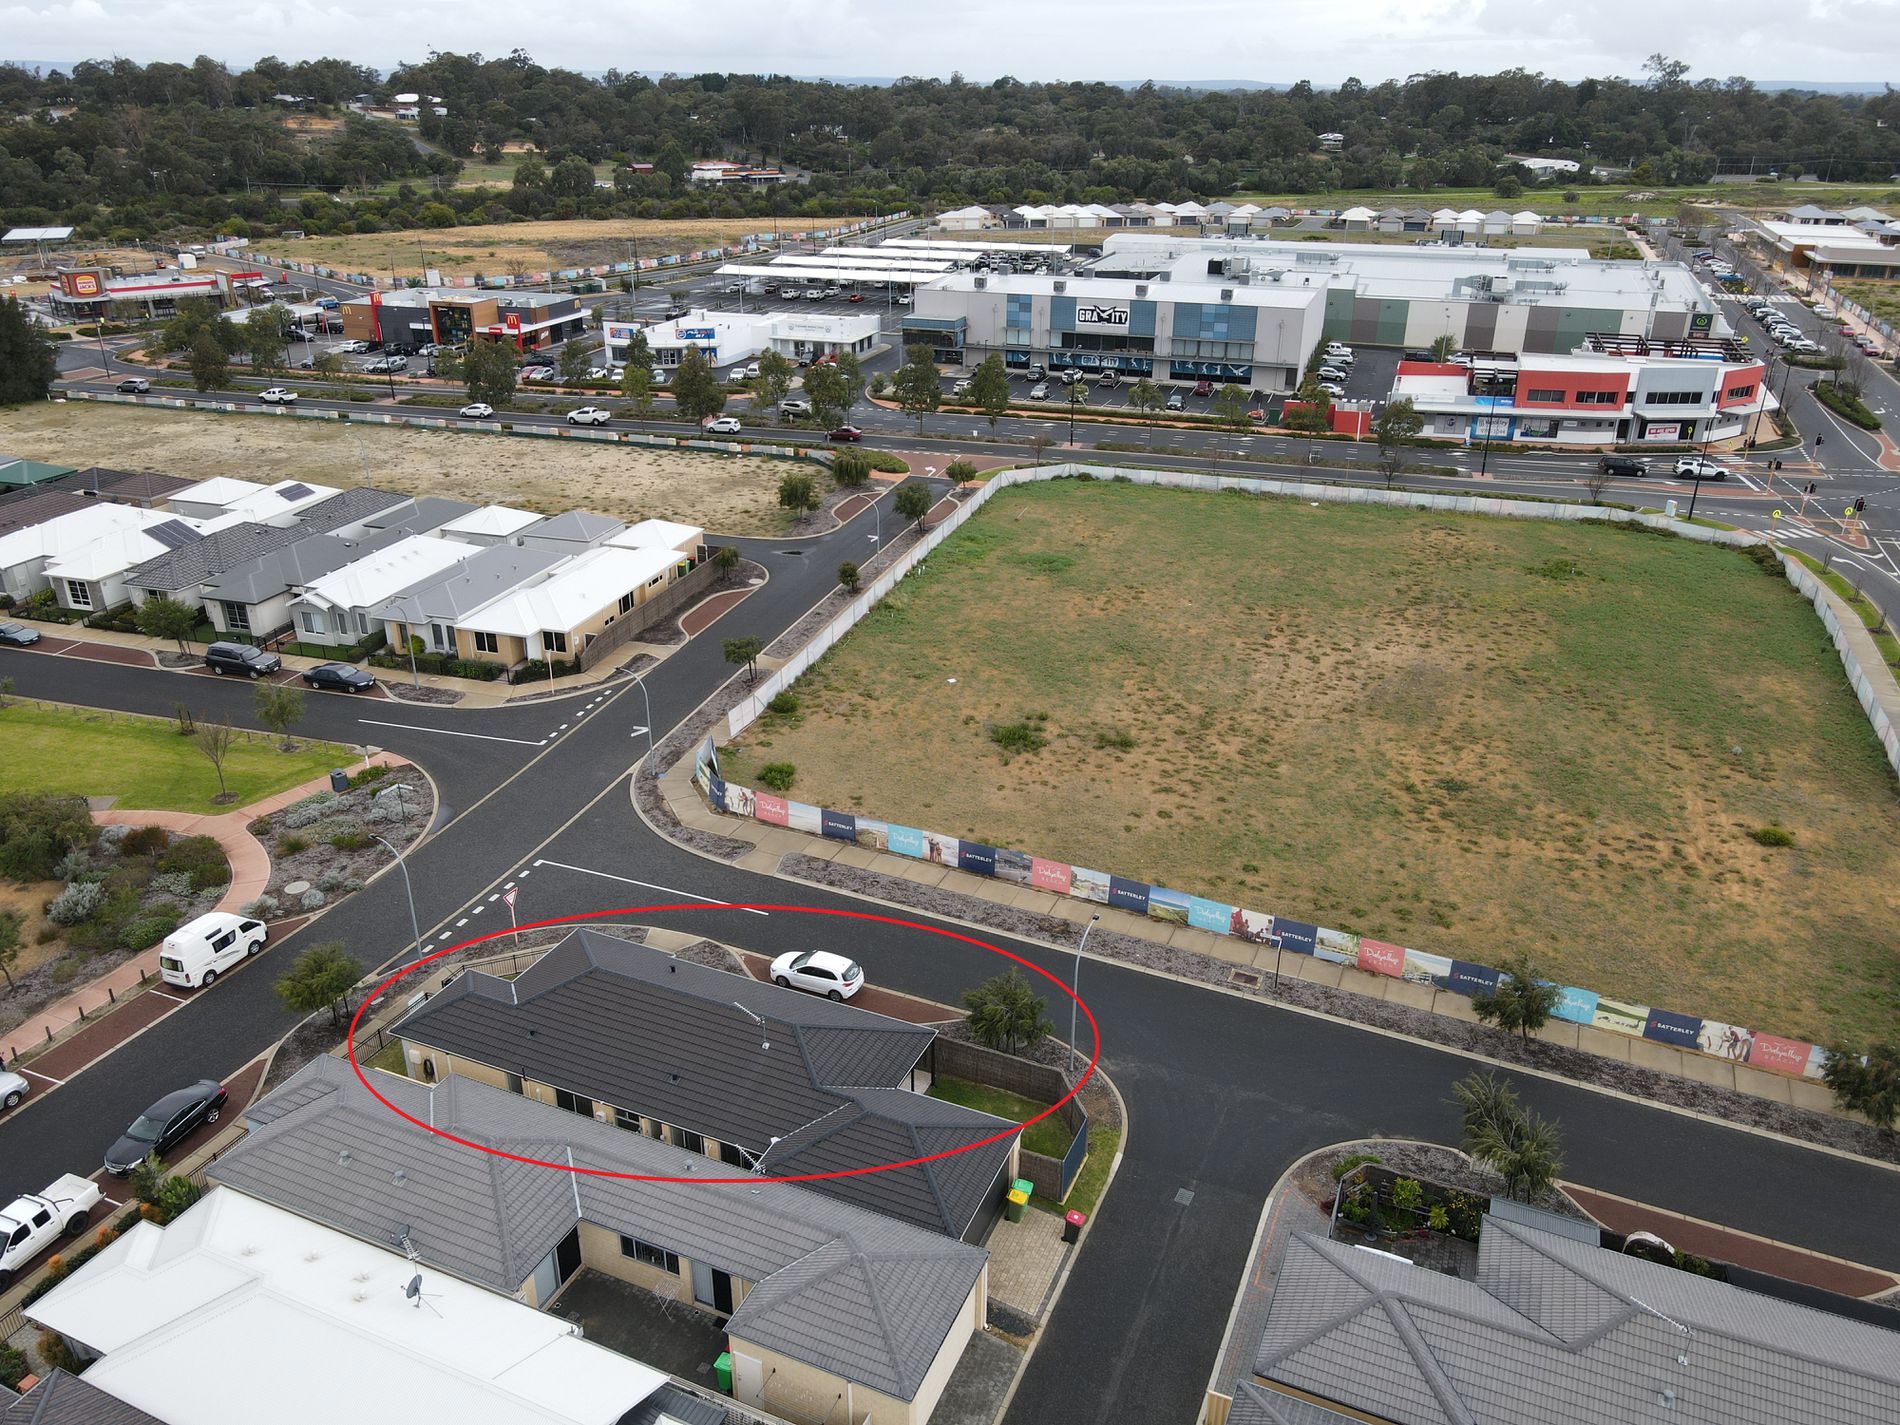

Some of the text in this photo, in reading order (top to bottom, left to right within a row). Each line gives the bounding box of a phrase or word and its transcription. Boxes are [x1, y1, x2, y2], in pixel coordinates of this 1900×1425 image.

[1079, 306, 1127, 323] GRAVITY
[966, 853, 992, 863] SATTERLEY
[1117, 889, 1146, 900] SATTERLEY
[1281, 931, 1313, 943] SATTERLEY
[1459, 974, 1494, 987] SATTERLEY
[1657, 1022, 1695, 1036] SATTERLEY
